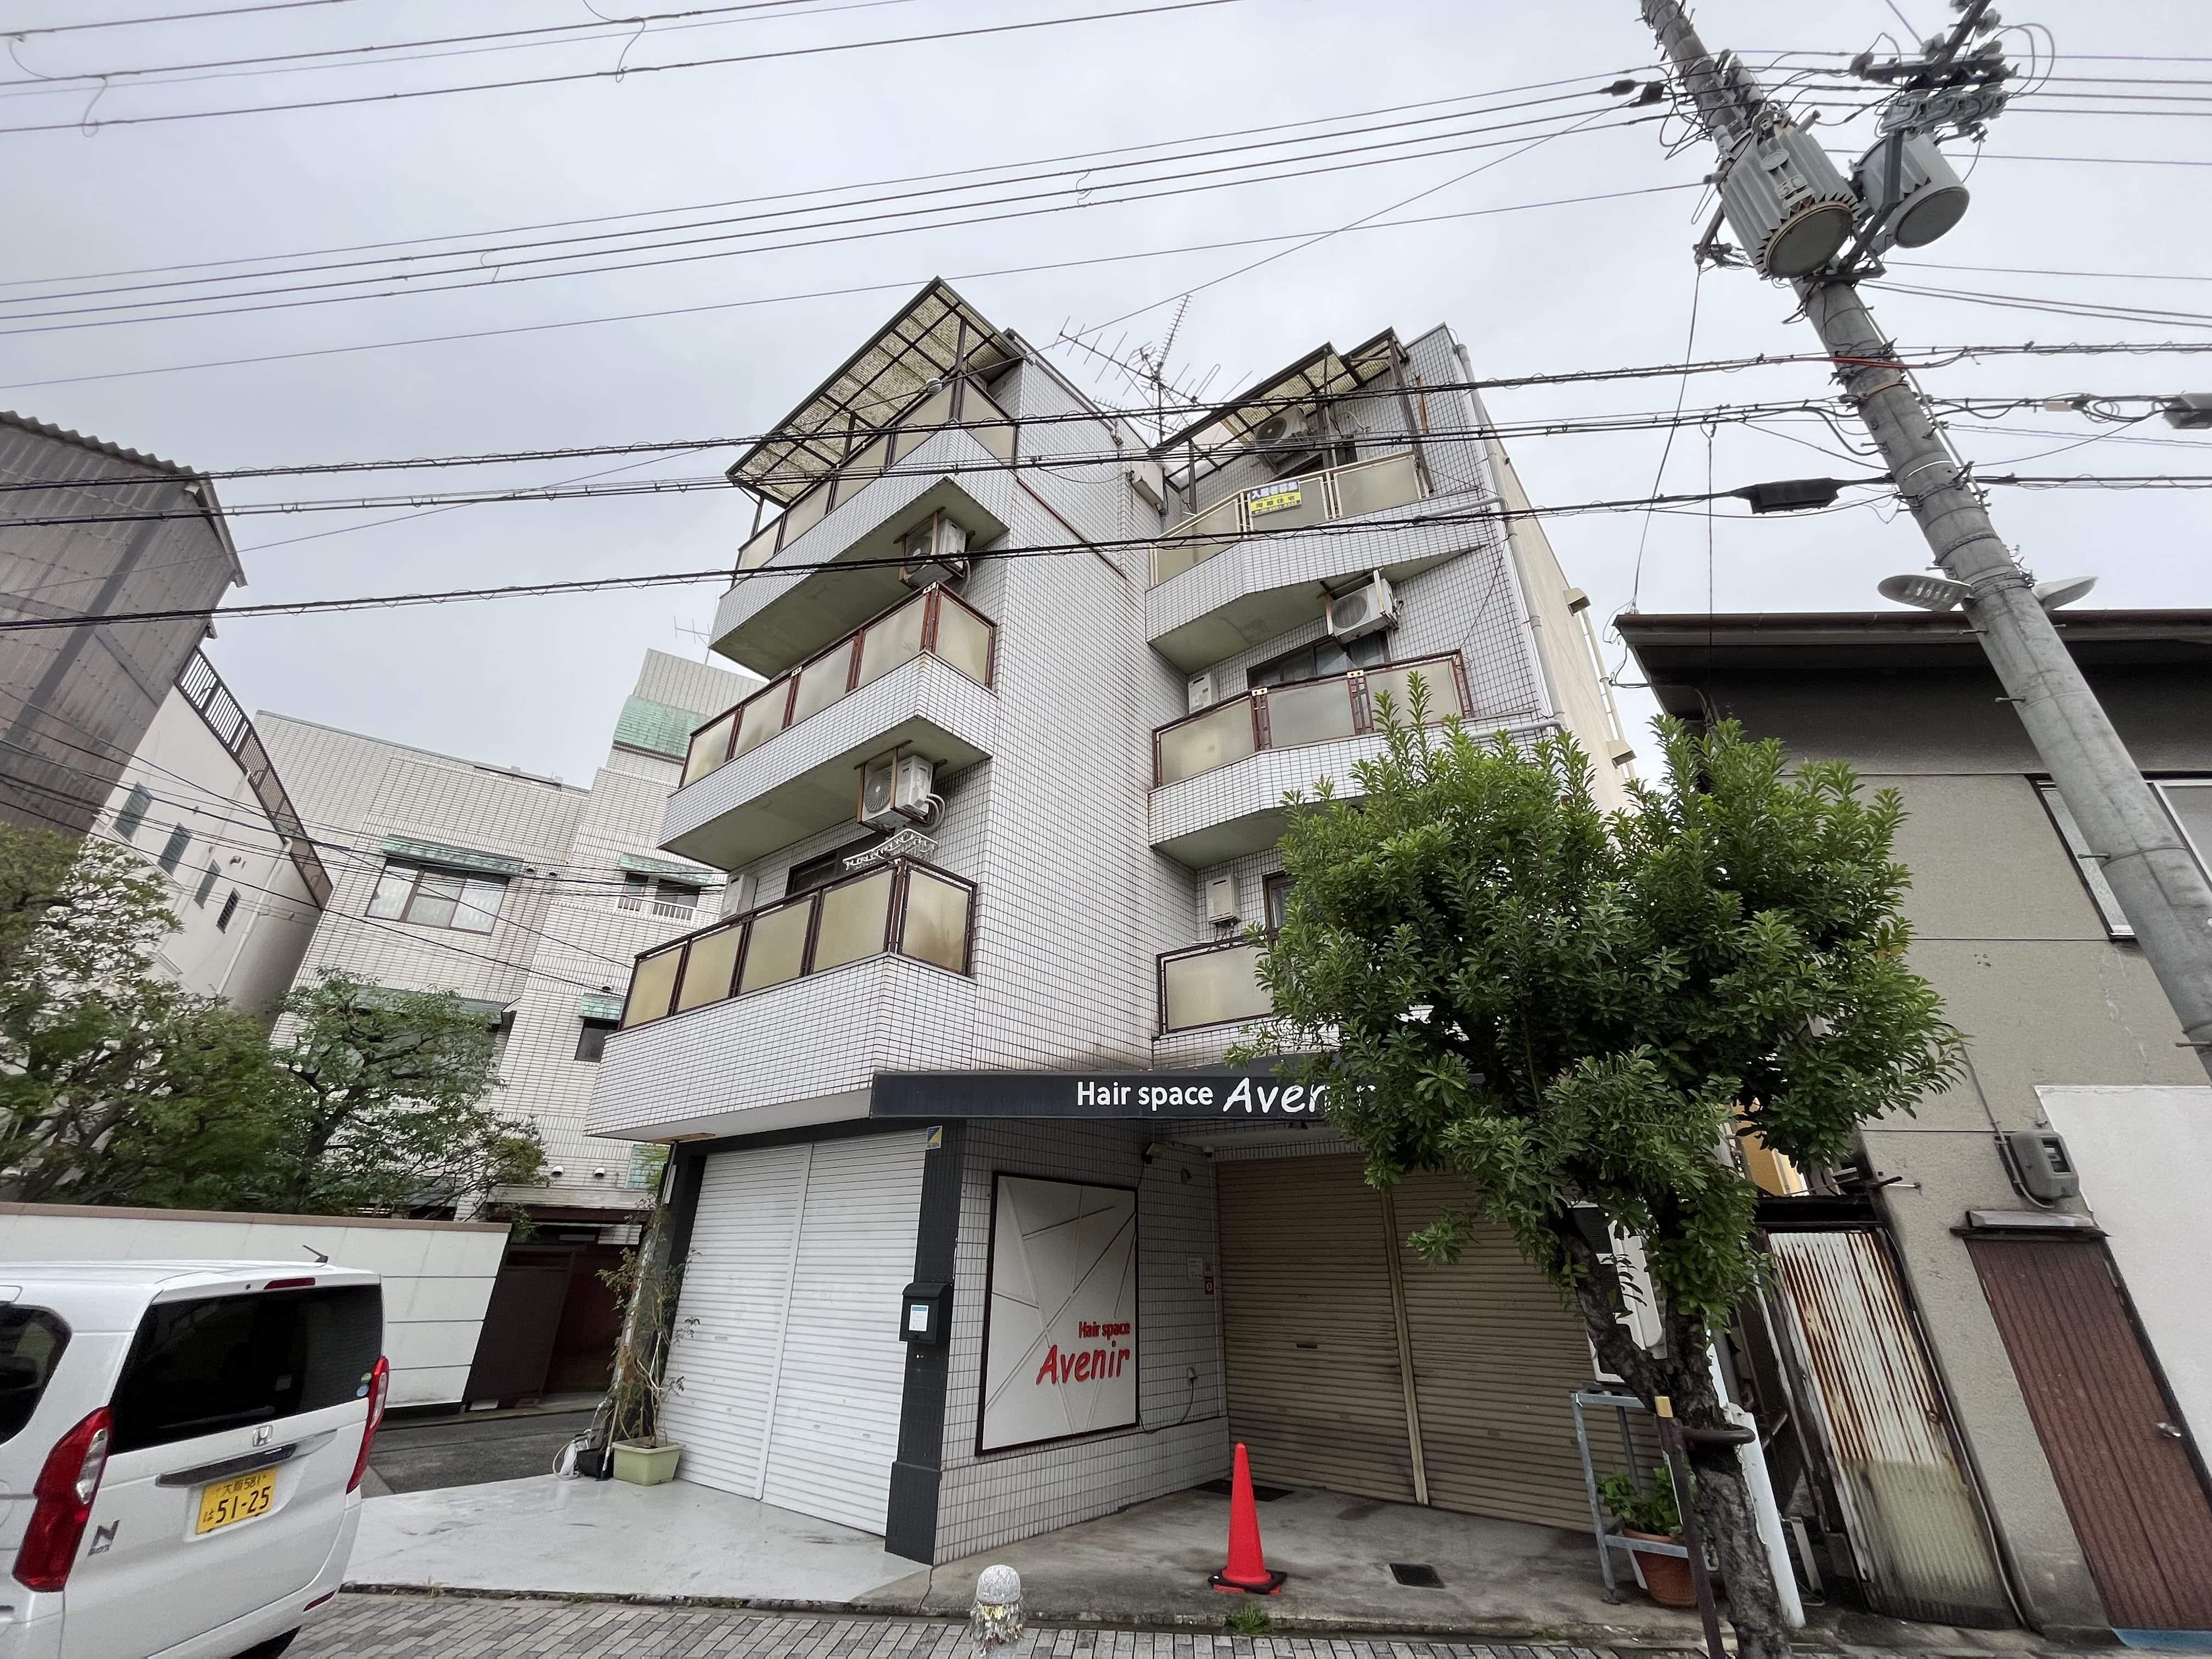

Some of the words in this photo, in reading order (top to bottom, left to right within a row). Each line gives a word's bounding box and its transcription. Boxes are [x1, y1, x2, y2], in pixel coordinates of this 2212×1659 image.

[1077, 1081, 1131, 1105] Hair
[1138, 1084, 1214, 1111] space
[1222, 1077, 1376, 1114] Aven
[1079, 1321, 1101, 1338] Hair
[1102, 1322, 1131, 1340] space
[1036, 1340, 1130, 1385] Avenir
[215, 1486, 272, 1524] 51-25
[92, 1519, 120, 1547] N
